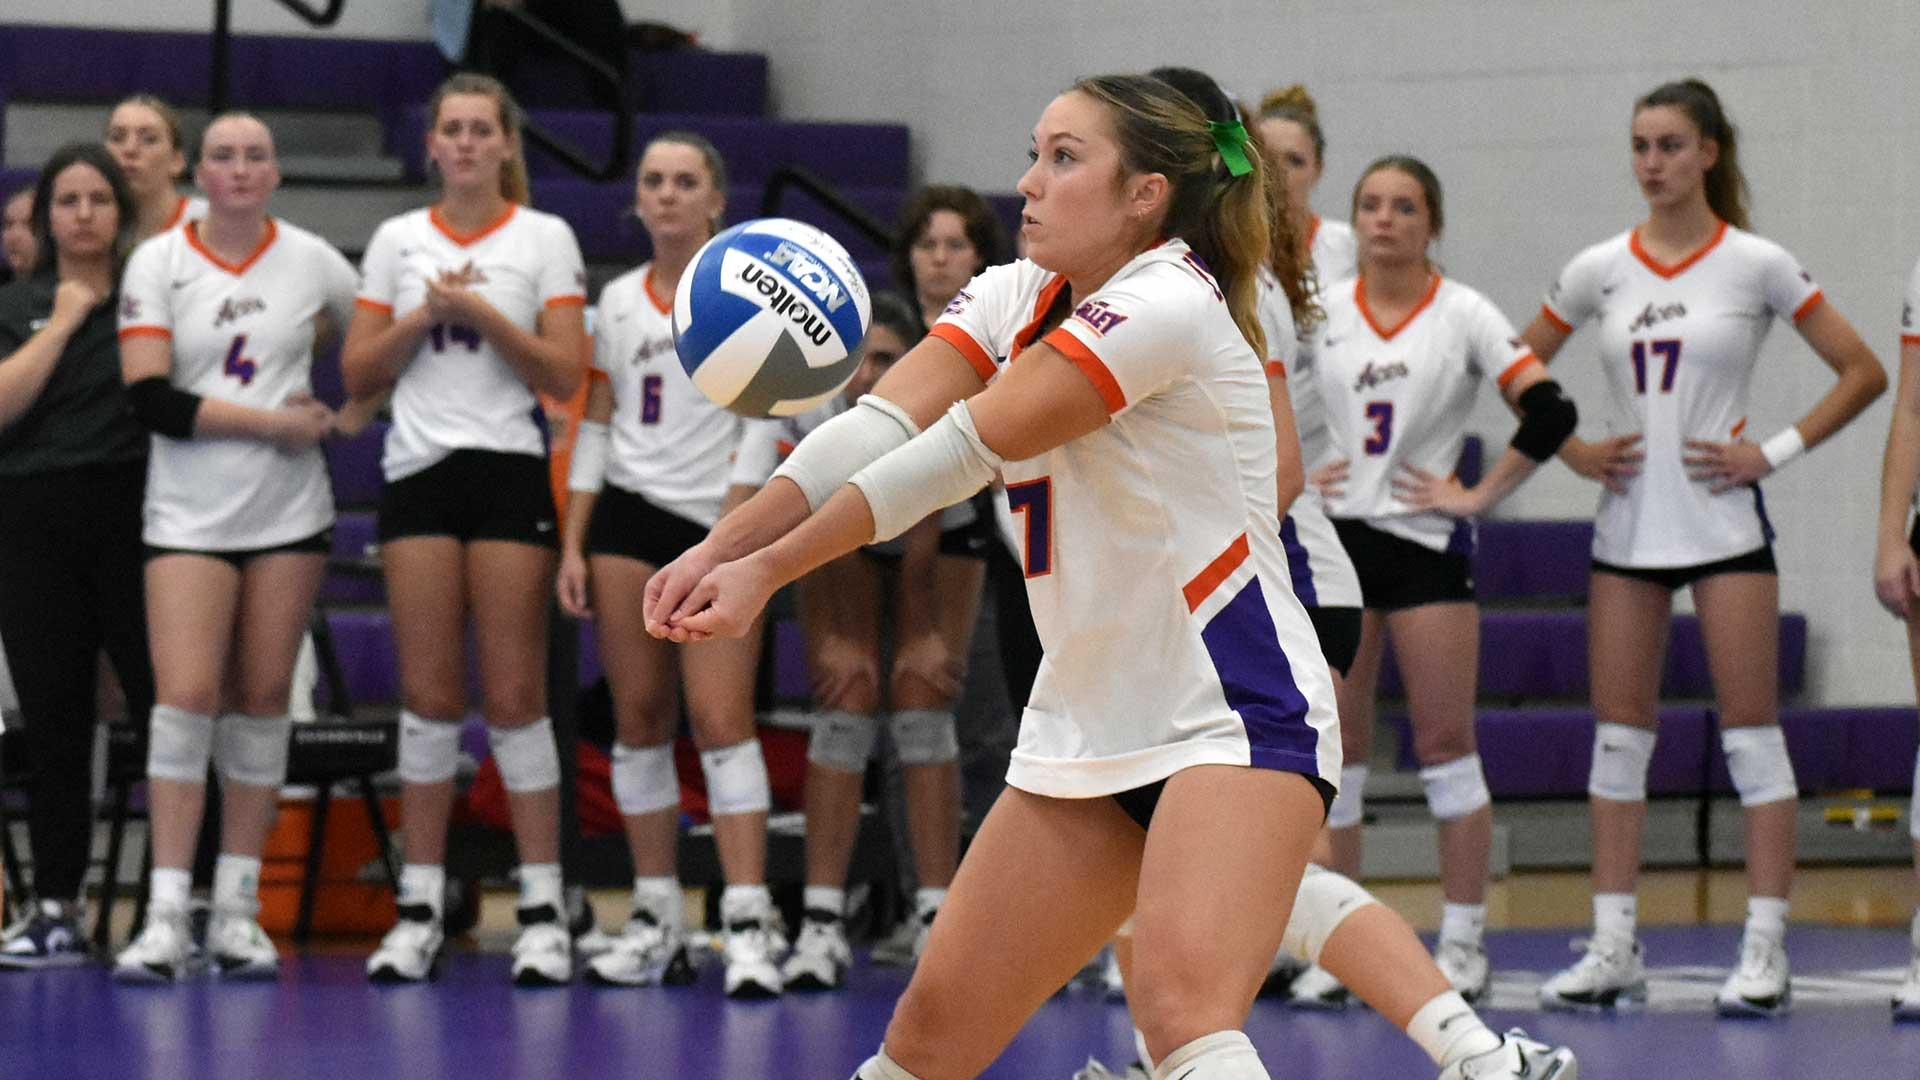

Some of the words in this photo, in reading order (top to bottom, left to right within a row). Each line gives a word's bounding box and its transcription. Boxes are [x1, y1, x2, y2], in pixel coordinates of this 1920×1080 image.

[771, 241, 849, 314] NCAA
[740, 263, 832, 347] molten
[224, 333, 256, 385] 4
[1631, 340, 1681, 393] 17
[640, 374, 663, 425] 6
[1364, 400, 1394, 456] 3
